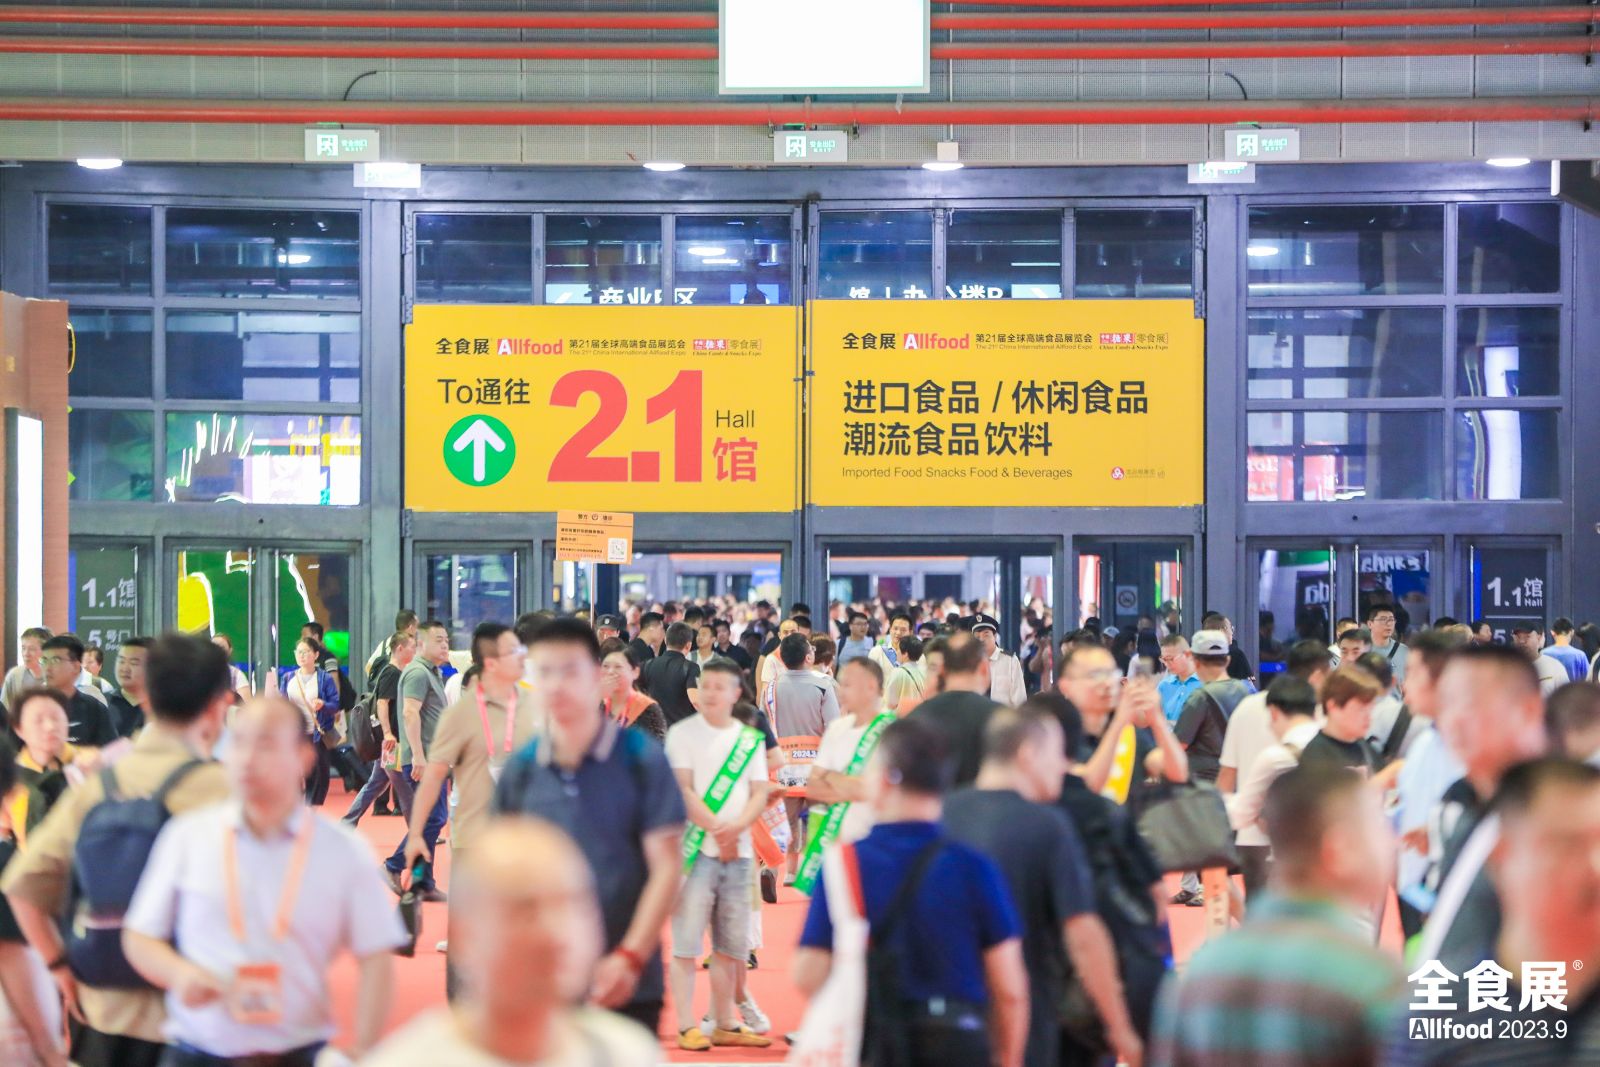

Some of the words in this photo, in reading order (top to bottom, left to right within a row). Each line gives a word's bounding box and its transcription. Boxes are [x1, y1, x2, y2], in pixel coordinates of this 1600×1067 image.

[436, 337, 490, 355] 全食展
[497, 338, 563, 355] Allfood
[842, 332, 897, 350] 全食展
[904, 332, 970, 350] Allfood
[437, 378, 531, 405] To通往
[843, 379, 980, 414] 进口食品
[1011, 379, 1149, 414] 休闲食品
[547, 370, 702, 482] 2.1
[715, 409, 755, 428] Hall
[843, 422, 1053, 456] 潮流食品饮料
[712, 436, 758, 482] 馆
[842, 466, 891, 479] Imported
[894, 466, 922, 477] Food
[925, 466, 967, 477] Snacks
[970, 466, 998, 477] Food
[1001, 467, 1010, 477] &
[1013, 467, 1073, 480] Beverages
[81, 577, 117, 608] 1.1
[1487, 576, 1522, 607] 1.1
[1523, 577, 1544, 598] 馆
[1524, 598, 1543, 607] Hall
[88, 629, 102, 648] 5
